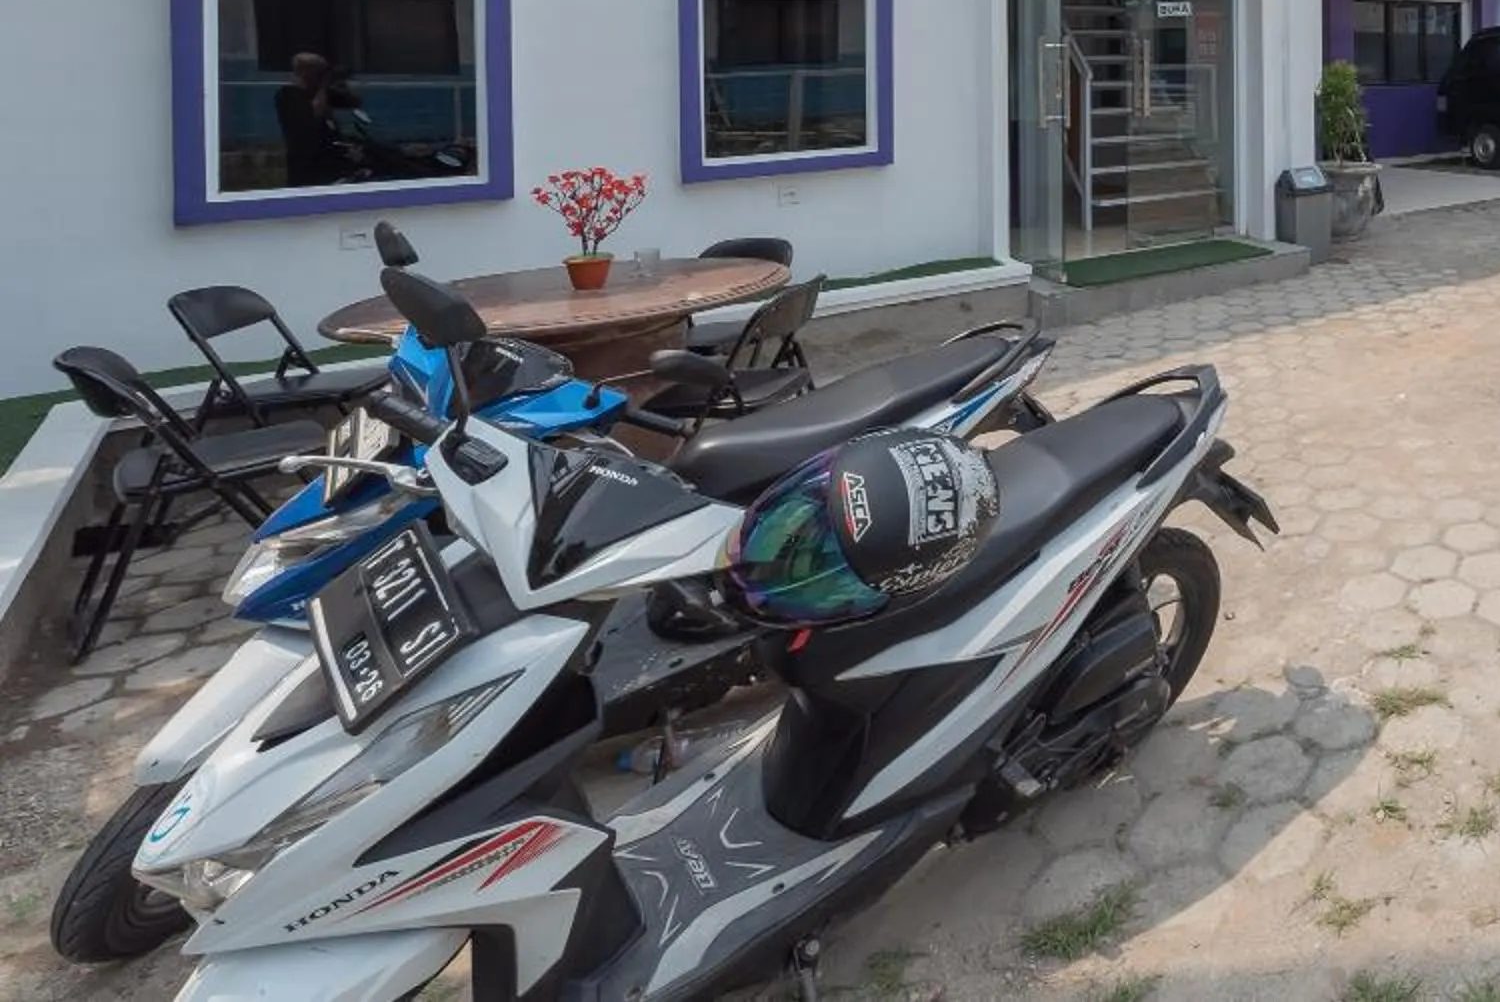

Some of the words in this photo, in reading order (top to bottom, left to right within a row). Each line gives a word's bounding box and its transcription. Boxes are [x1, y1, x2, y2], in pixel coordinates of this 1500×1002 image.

[588, 465, 640, 486] HONDA
[372, 557, 427, 622] 3211
[282, 869, 400, 934] HONDA
